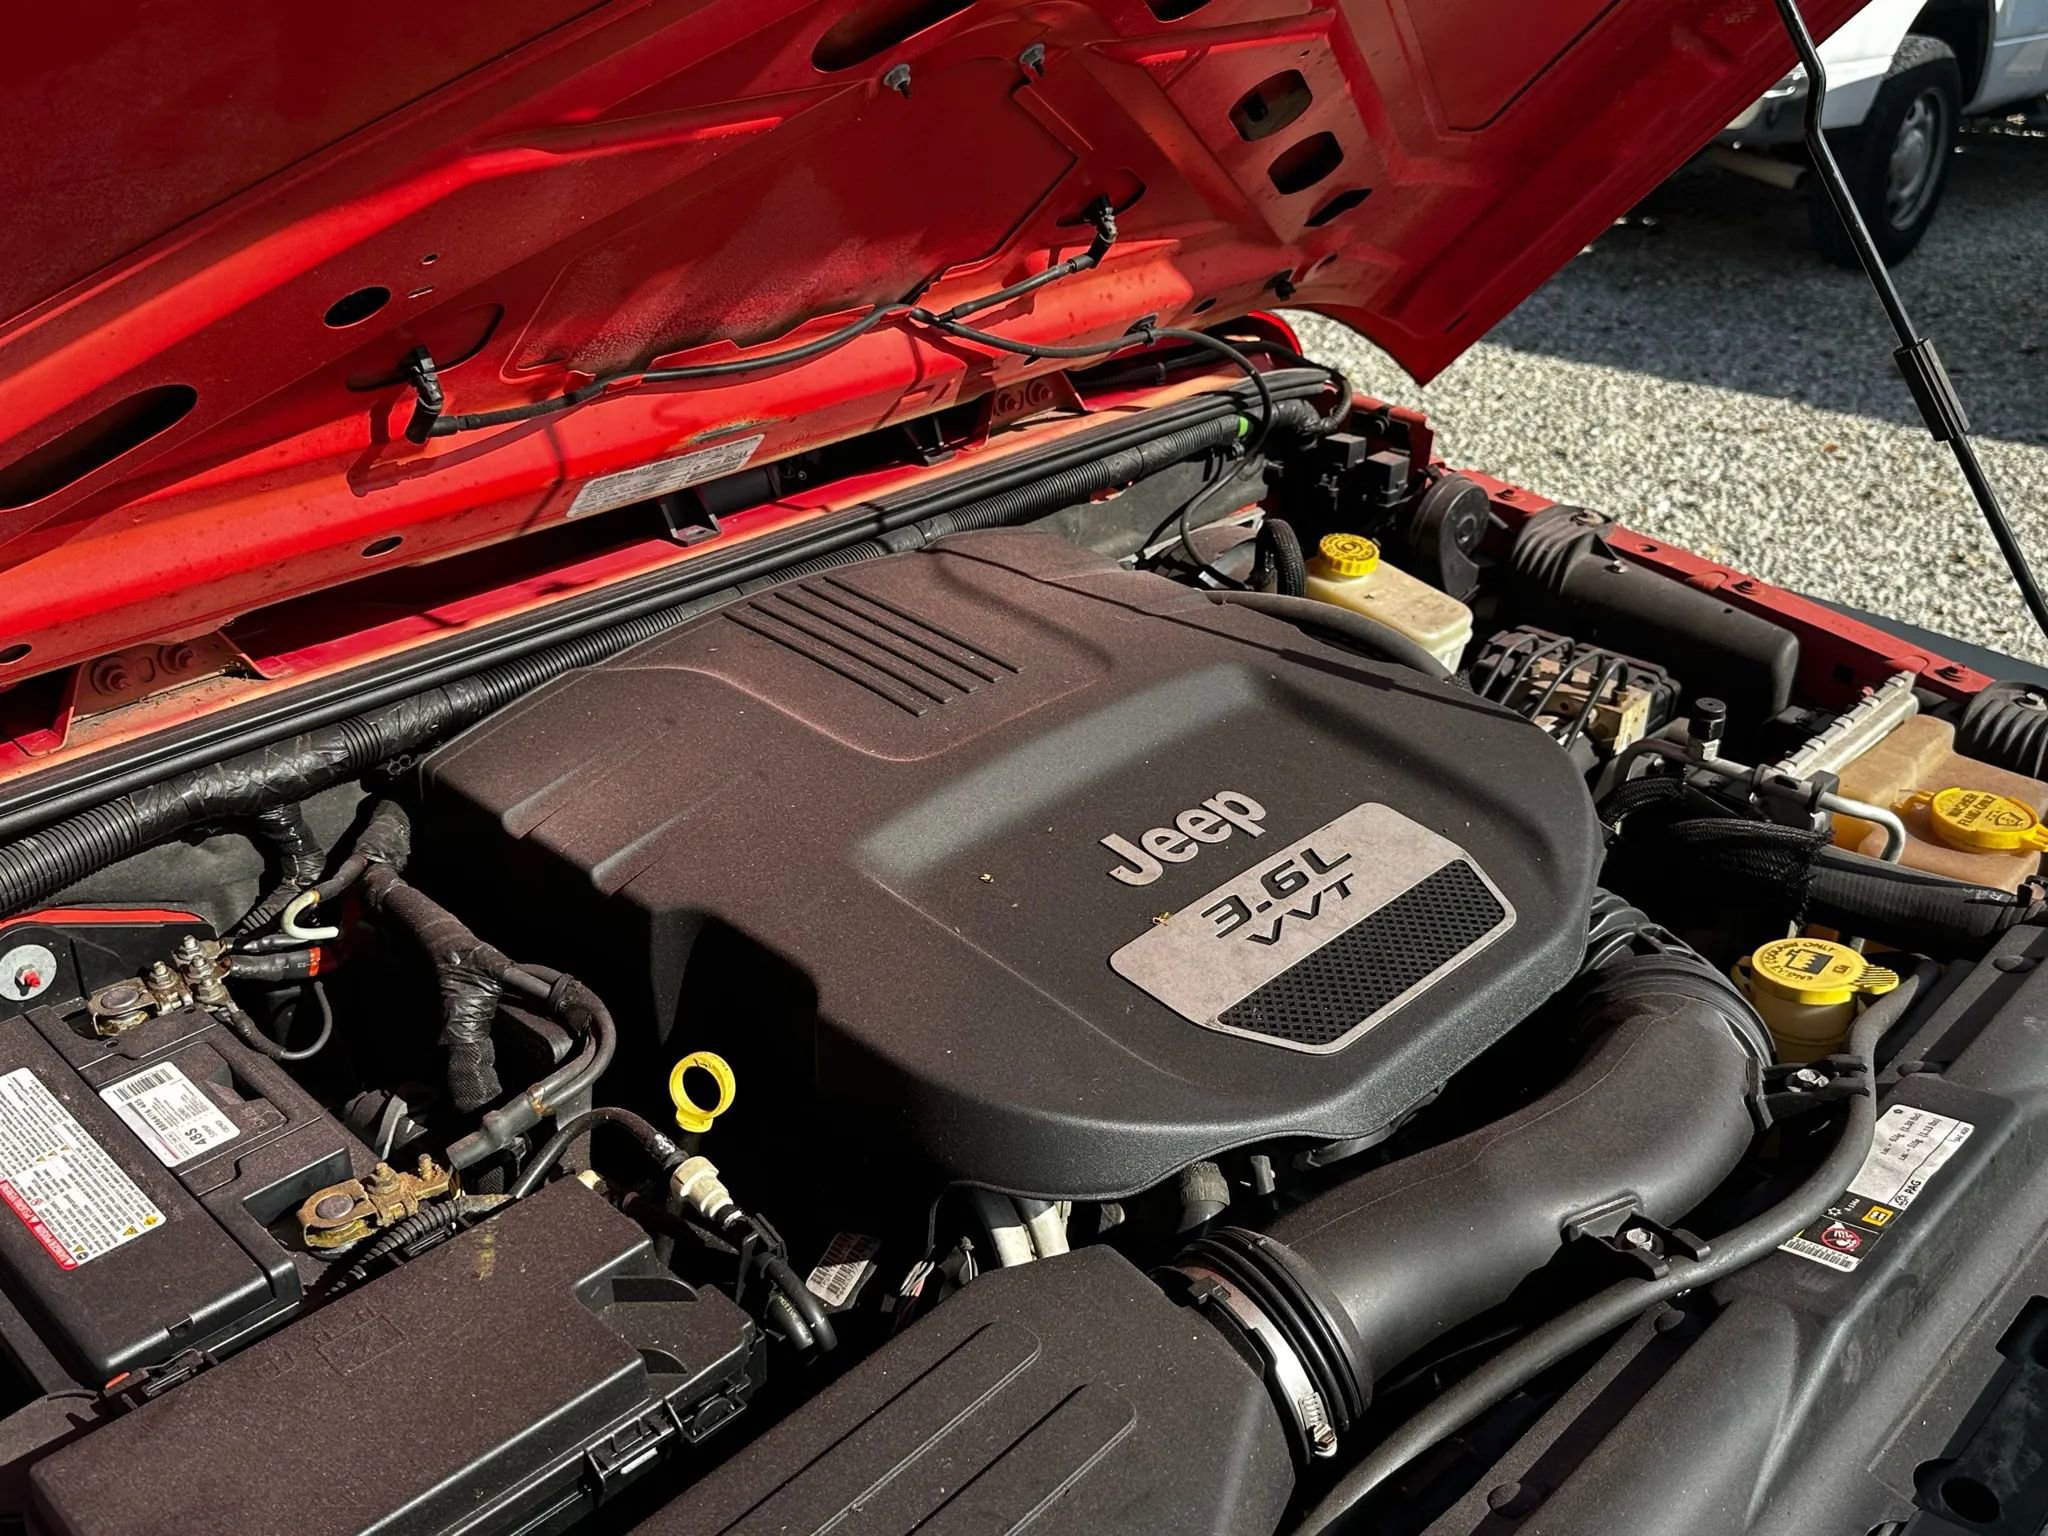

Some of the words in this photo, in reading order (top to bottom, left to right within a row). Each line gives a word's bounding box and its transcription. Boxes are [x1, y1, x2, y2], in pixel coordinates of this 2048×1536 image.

[1098, 790, 1266, 886] Jeep
[1202, 847, 1352, 938] 3.6L
[1247, 873, 1354, 946] VVT
[1802, 941, 1837, 951] ONLY
[185, 1126, 208, 1147] 48S
[1905, 1180, 1922, 1194] PAG
